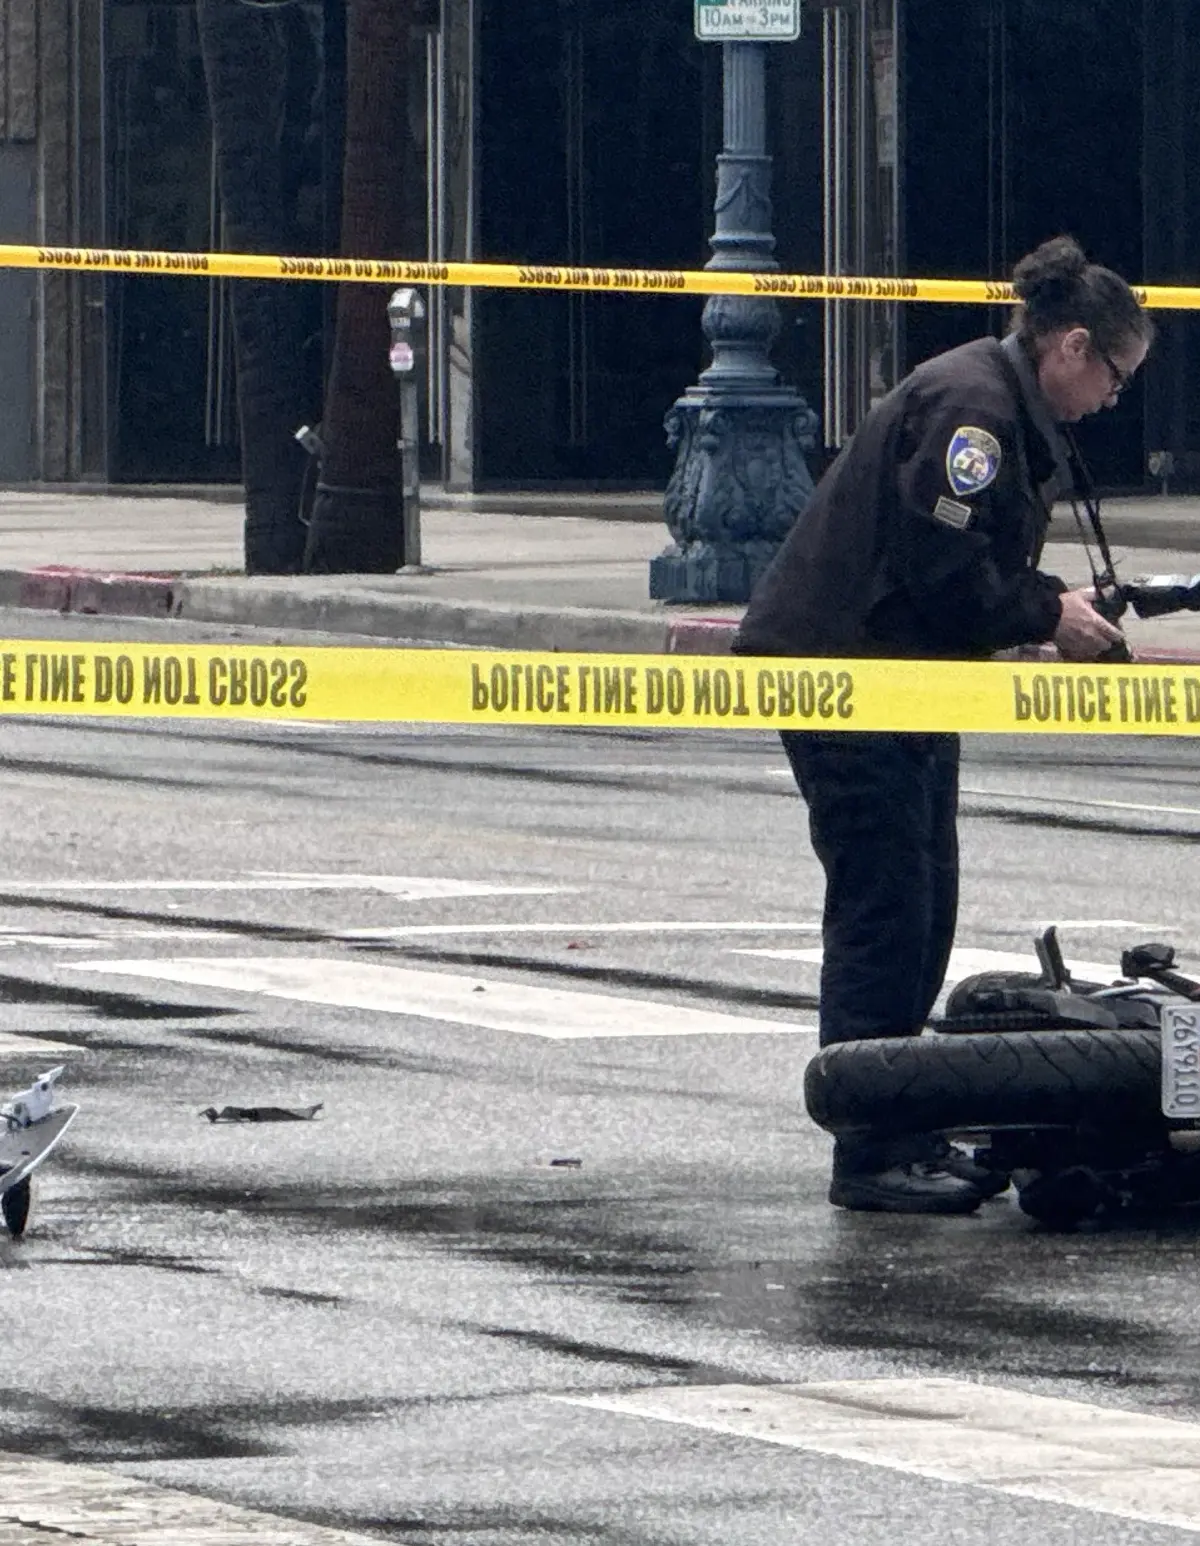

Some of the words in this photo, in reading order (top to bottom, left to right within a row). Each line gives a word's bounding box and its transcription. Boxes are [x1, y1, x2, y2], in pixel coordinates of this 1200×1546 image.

[704, 8, 744, 27] 10AM
[760, 8, 790, 26] 3PM
[39, 250, 81, 264] CROSS
[85, 252, 109, 265] NOT
[115, 254, 131, 266] DO
[136, 254, 162, 267] LINE
[165, 255, 209, 270] POLICE
[281, 259, 323, 275] CROSS
[327, 261, 351, 276] NOT
[355, 263, 372, 276] DO
[376, 263, 402, 277] LINE
[405, 264, 449, 280] POLICE
[519, 268, 561, 284] CROSS
[564, 270, 590, 285] NOT
[593, 272, 610, 286] DO
[614, 272, 639, 287] LINE
[642, 273, 685, 288] POLICE
[754, 277, 796, 292] CROSS
[799, 279, 823, 293] NOT
[827, 280, 844, 294] DO
[847, 280, 873, 295] LINE
[876, 281, 917, 297] POLICE
[1173, 1015, 1199, 1105] 26Y9110
